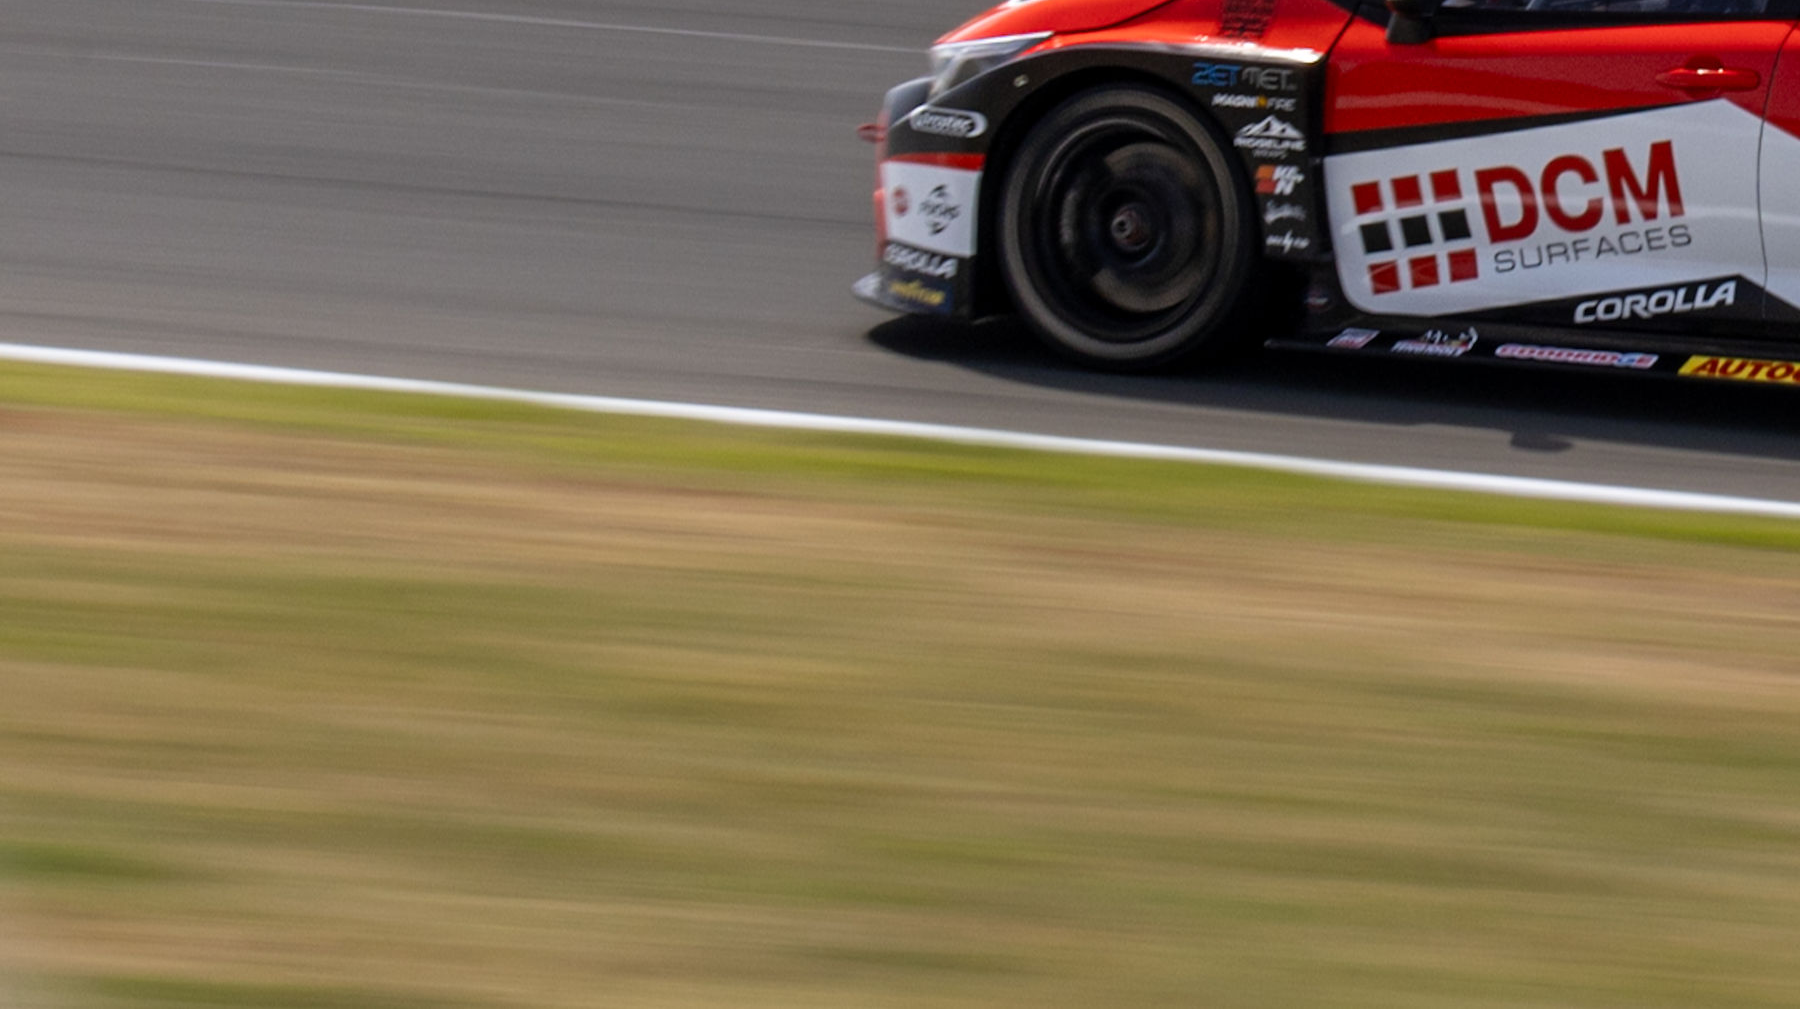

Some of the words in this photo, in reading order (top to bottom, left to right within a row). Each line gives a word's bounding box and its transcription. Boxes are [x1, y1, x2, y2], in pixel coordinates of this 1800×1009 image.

[1474, 139, 1686, 245] DCM
[1493, 223, 1693, 274] SURFACES
[1573, 280, 1738, 323] COROLLA
